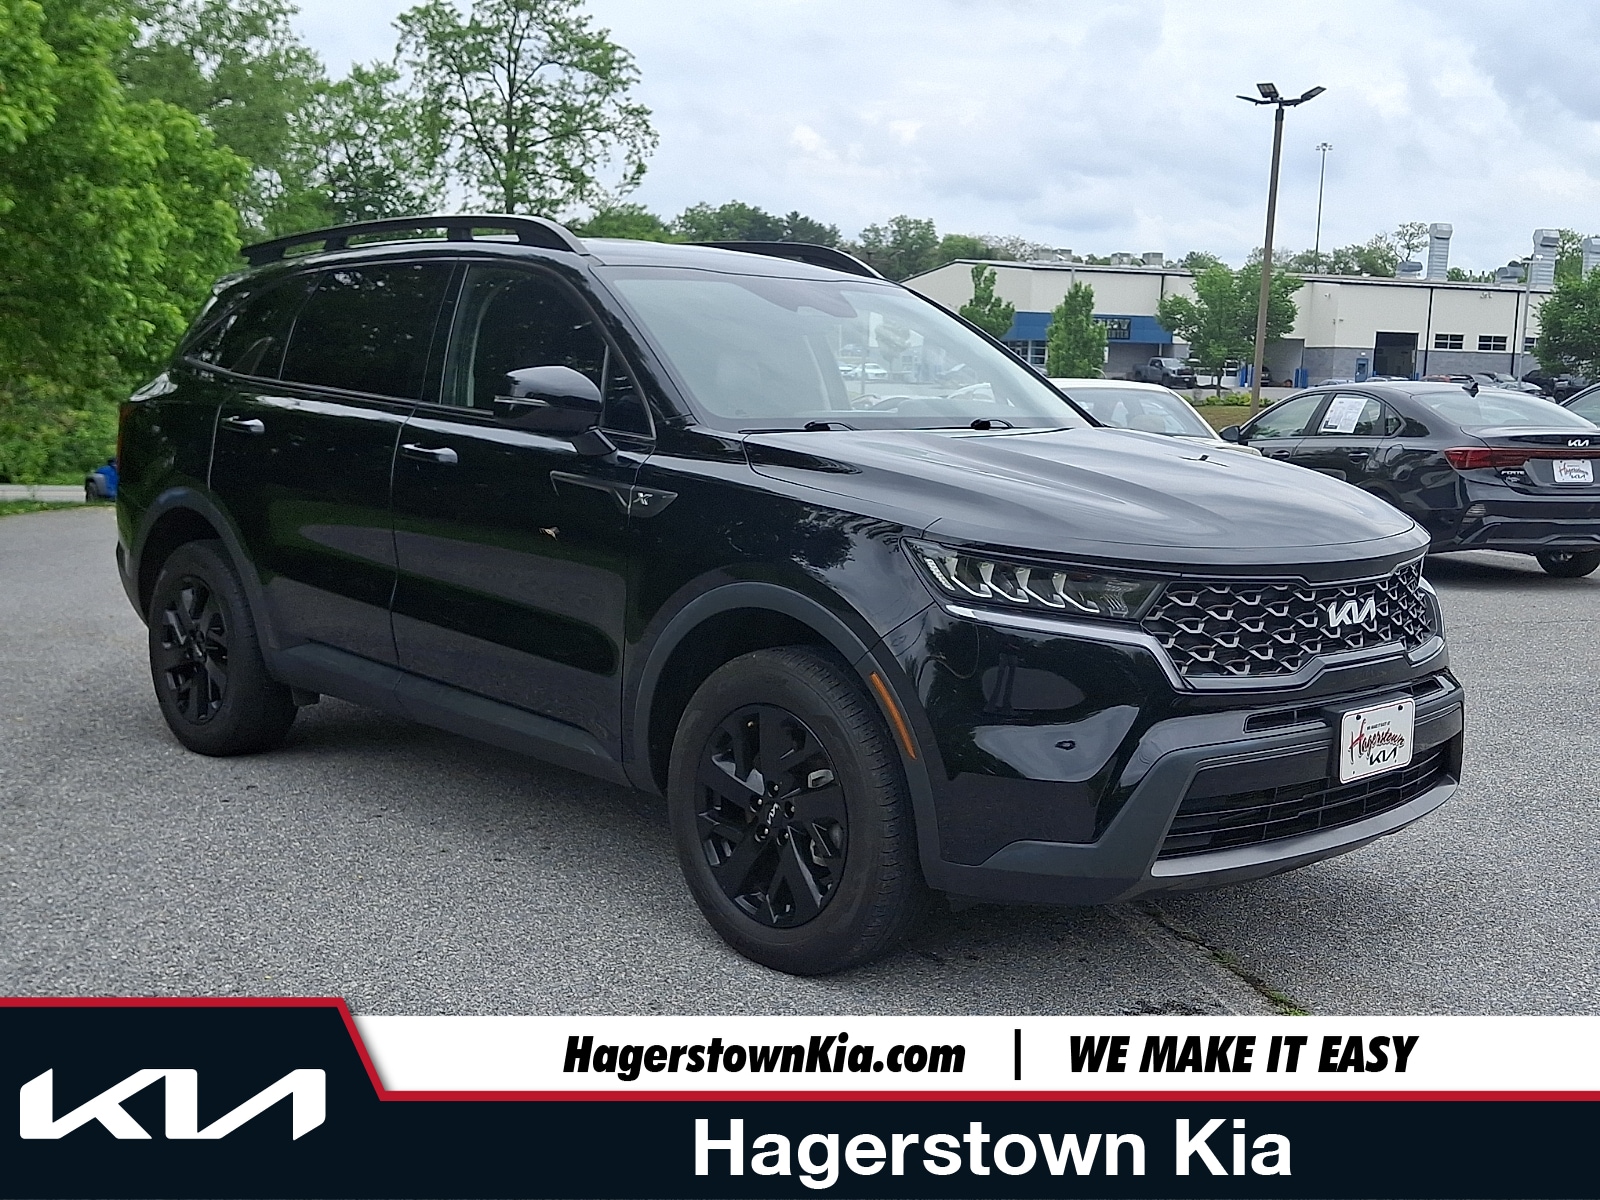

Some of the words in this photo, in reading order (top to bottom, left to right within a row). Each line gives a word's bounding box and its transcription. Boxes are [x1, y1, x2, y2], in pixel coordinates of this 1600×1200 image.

[1327, 598, 1376, 627] KIA
[1347, 718, 1405, 765] Hagerstown
[1369, 746, 1397, 766] KIA
